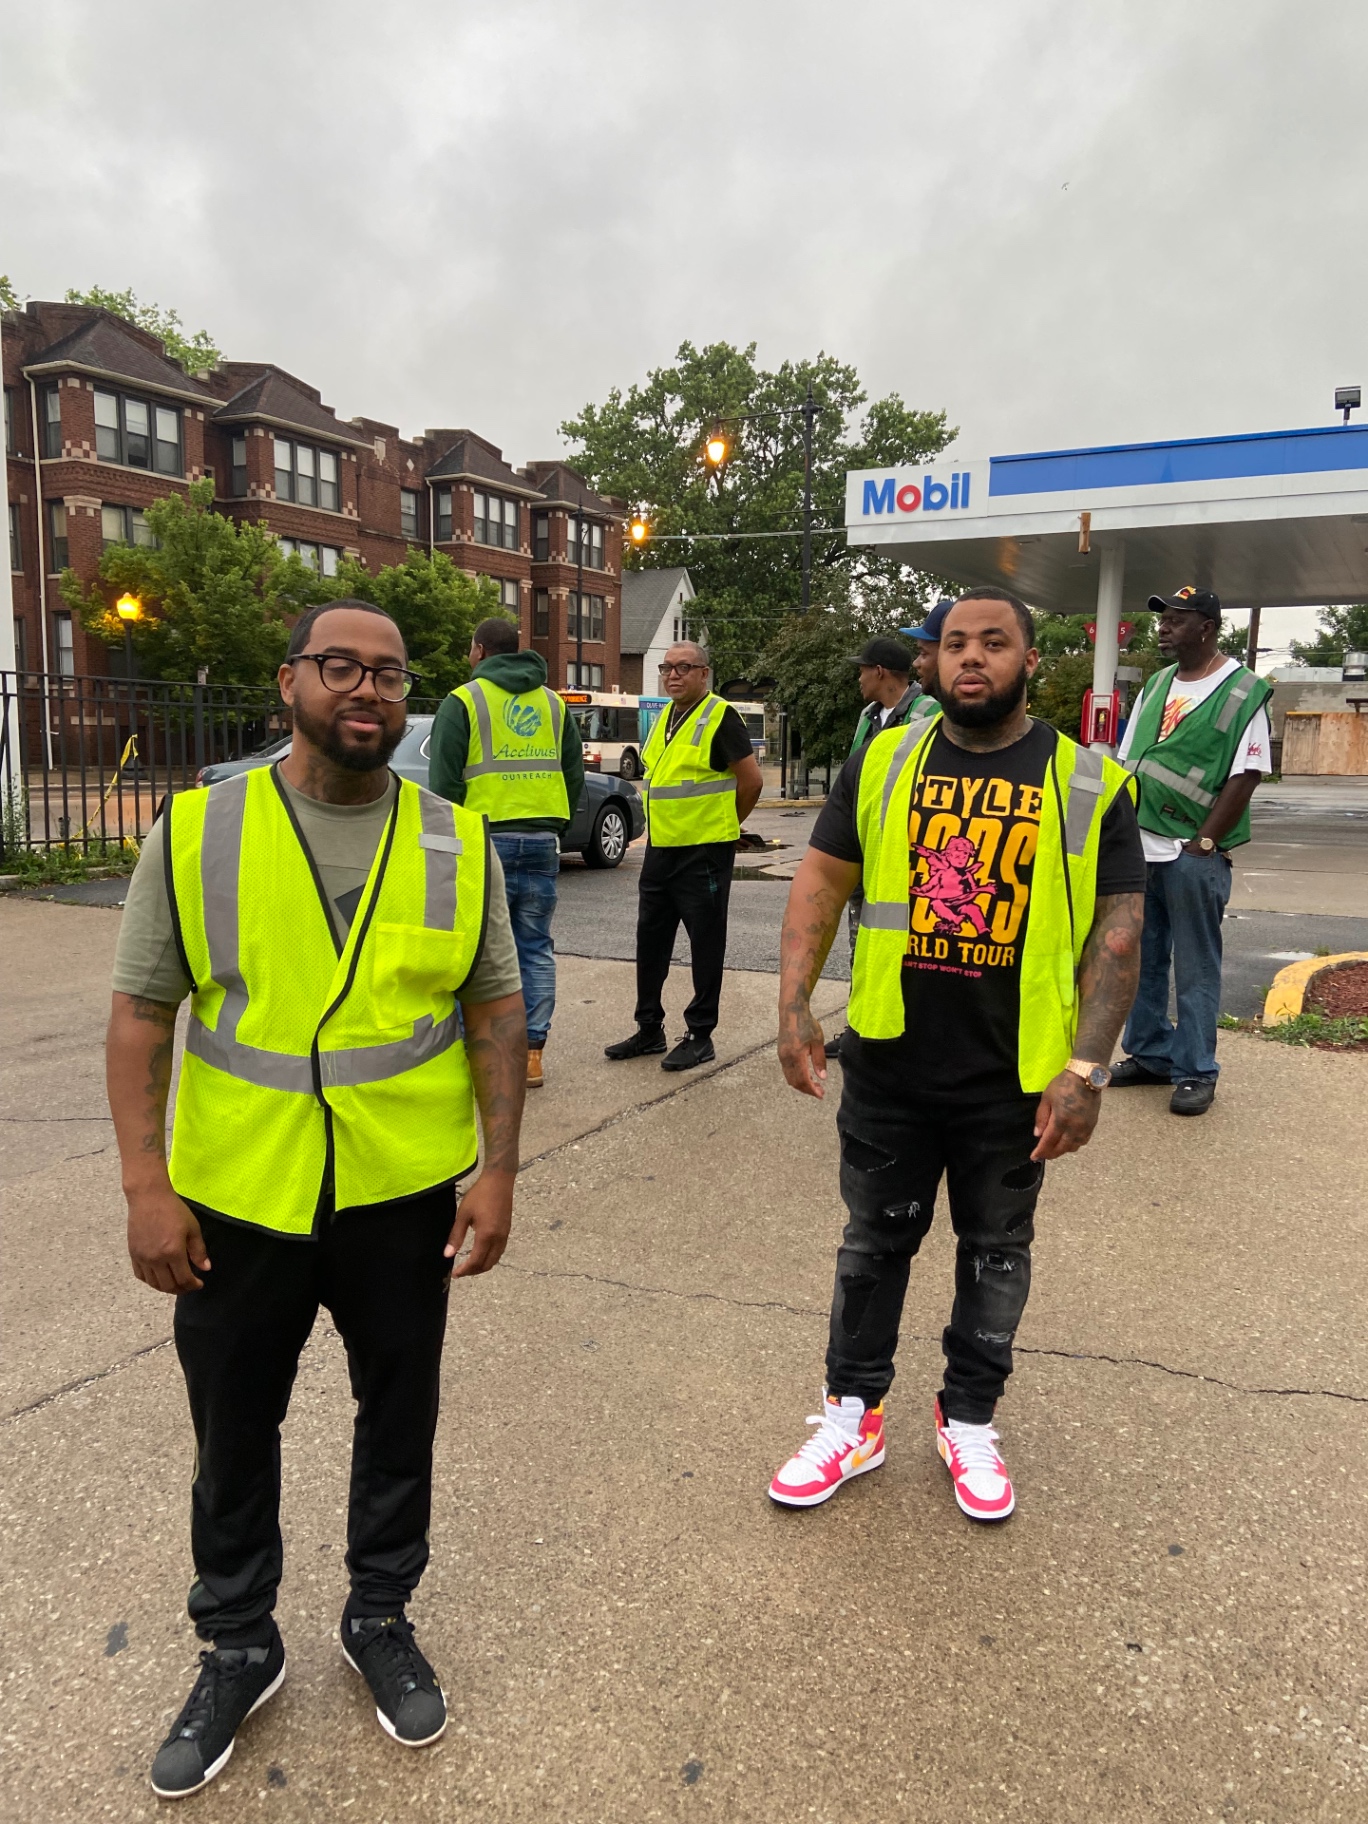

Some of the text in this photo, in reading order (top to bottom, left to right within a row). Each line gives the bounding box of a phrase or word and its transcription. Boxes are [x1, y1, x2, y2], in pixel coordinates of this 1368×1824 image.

[862, 472, 971, 515] Mobil
[1089, 626, 1095, 634] 6
[1120, 627, 1125, 635] 5
[493, 744, 556, 759] Acclivus
[502, 772, 552, 781] OUTREACH
[906, 935, 1015, 966] RLD TOUR
[964, 969, 982, 978] STOP
